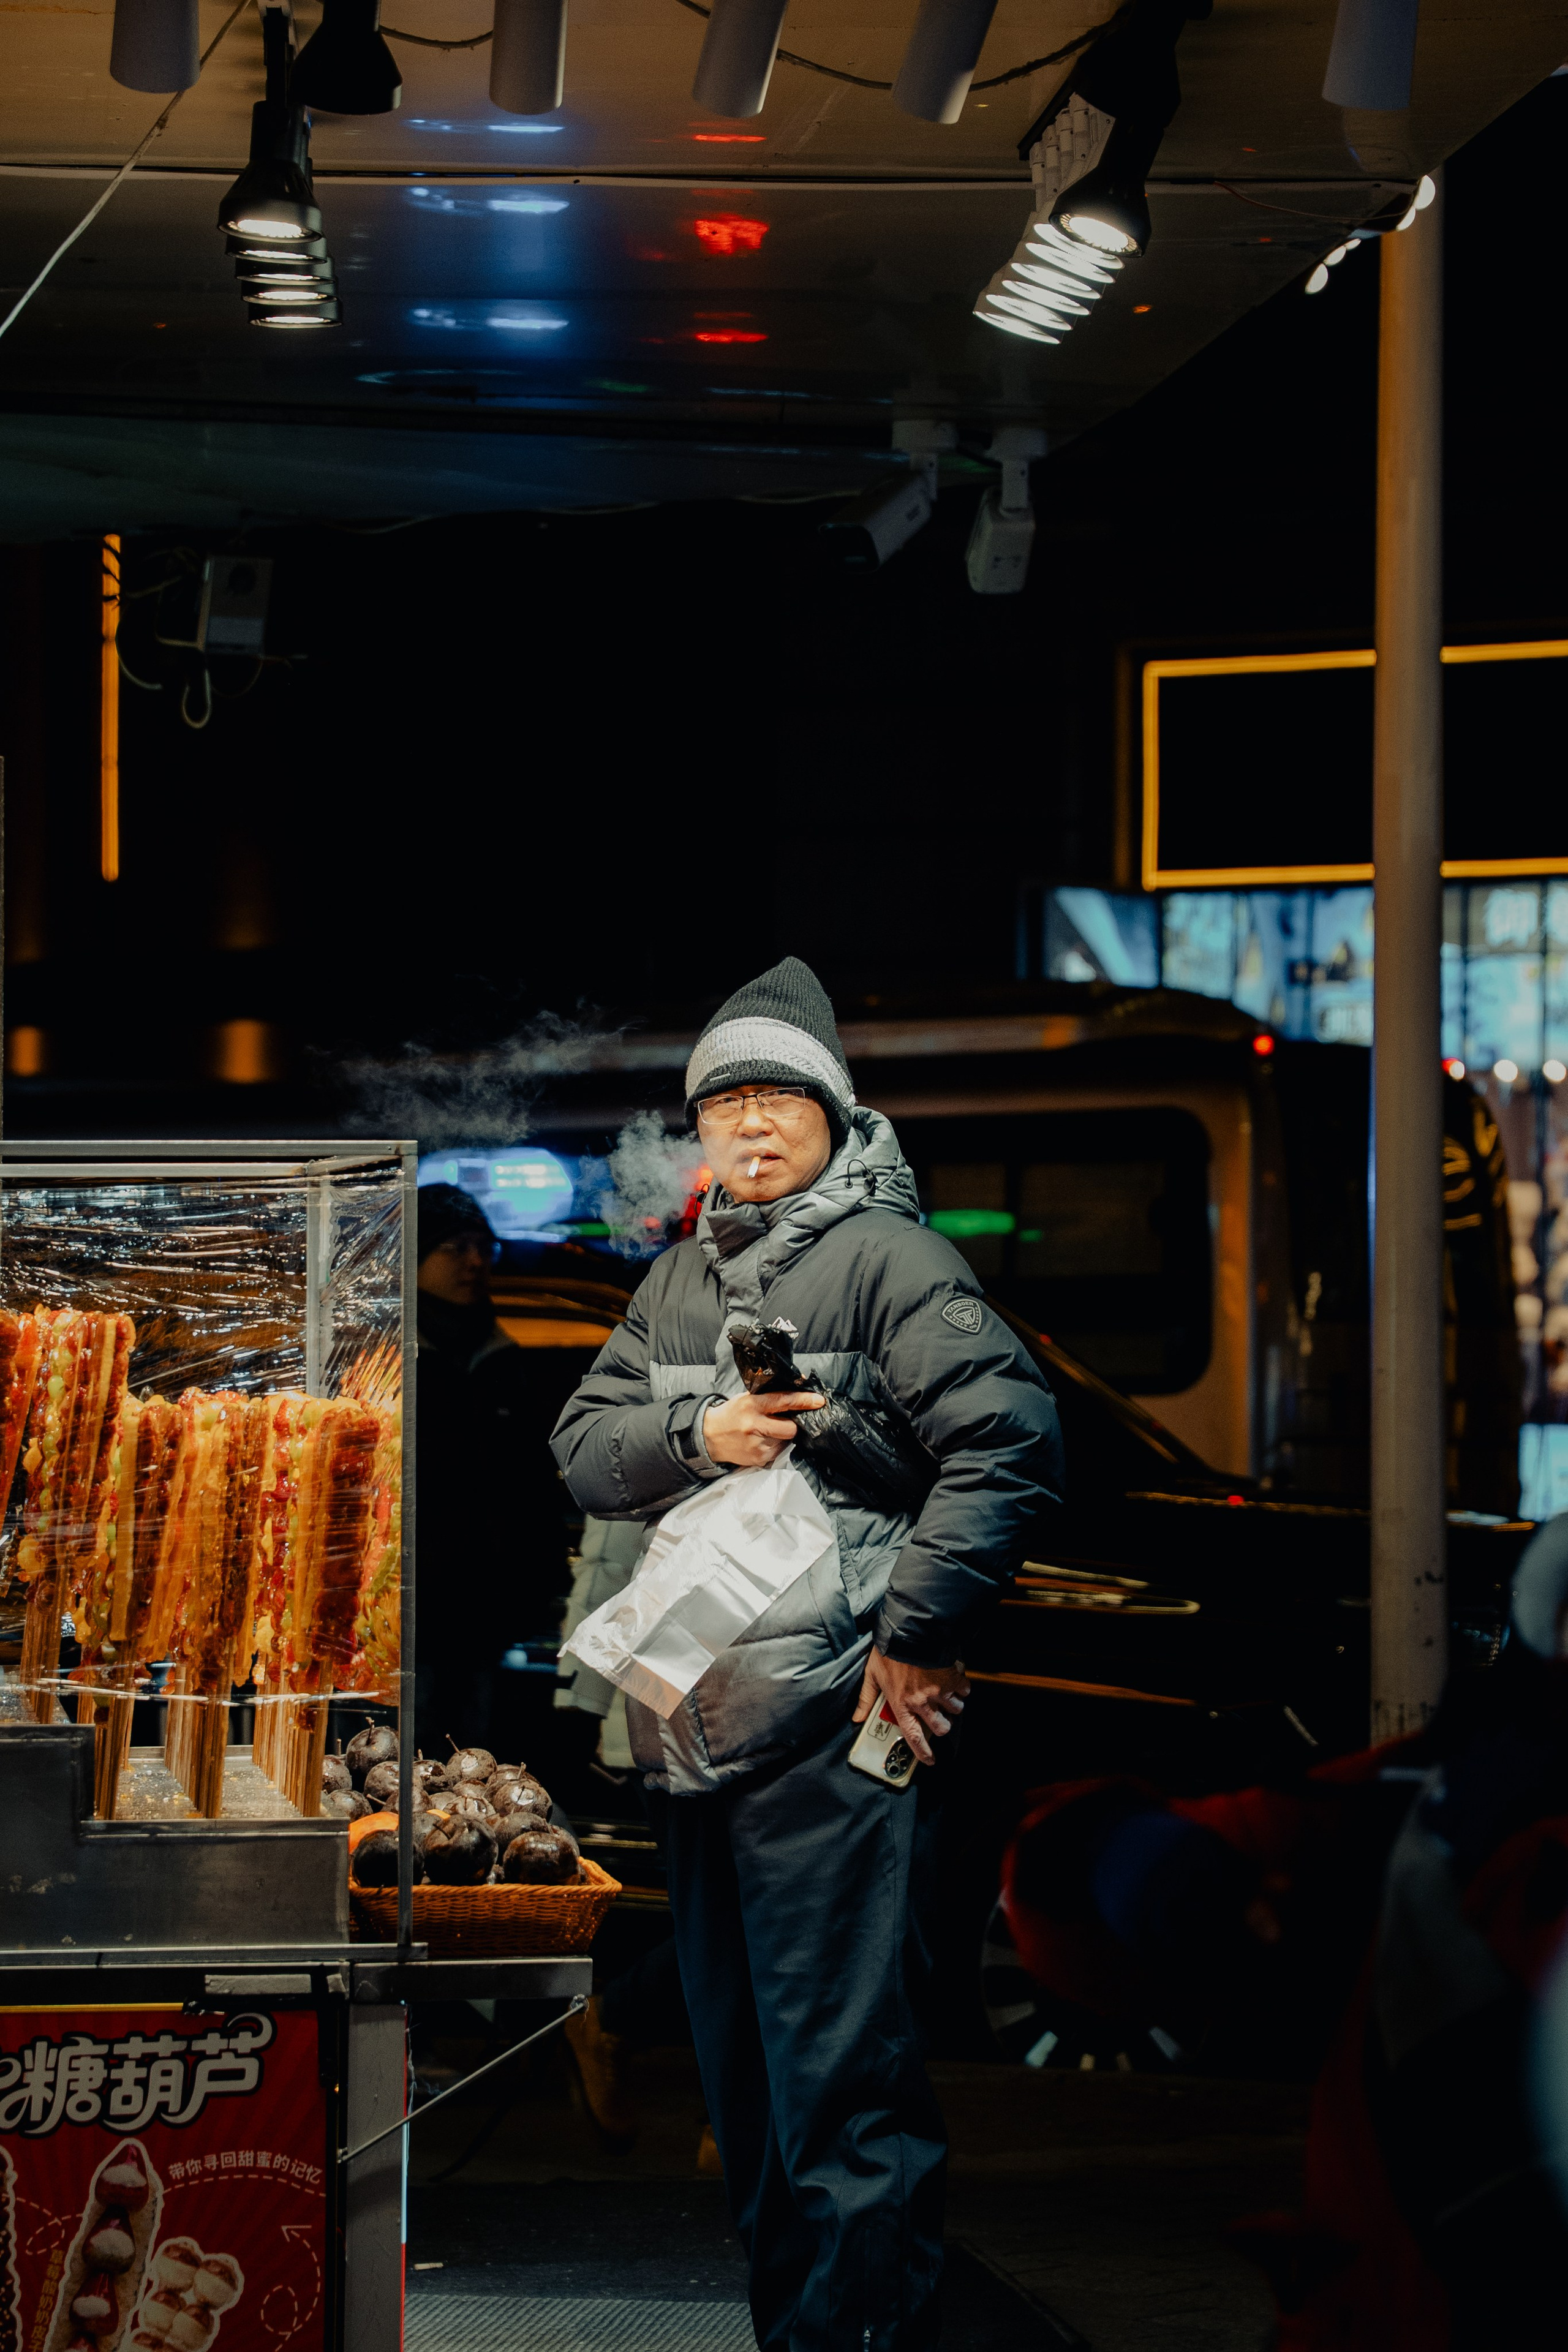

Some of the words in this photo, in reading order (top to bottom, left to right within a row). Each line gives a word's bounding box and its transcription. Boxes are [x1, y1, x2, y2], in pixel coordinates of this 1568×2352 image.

[947, 1301, 974, 1313] TANBOER
[168, 2149, 323, 2185] 带你寻回甜蜜的记忆
